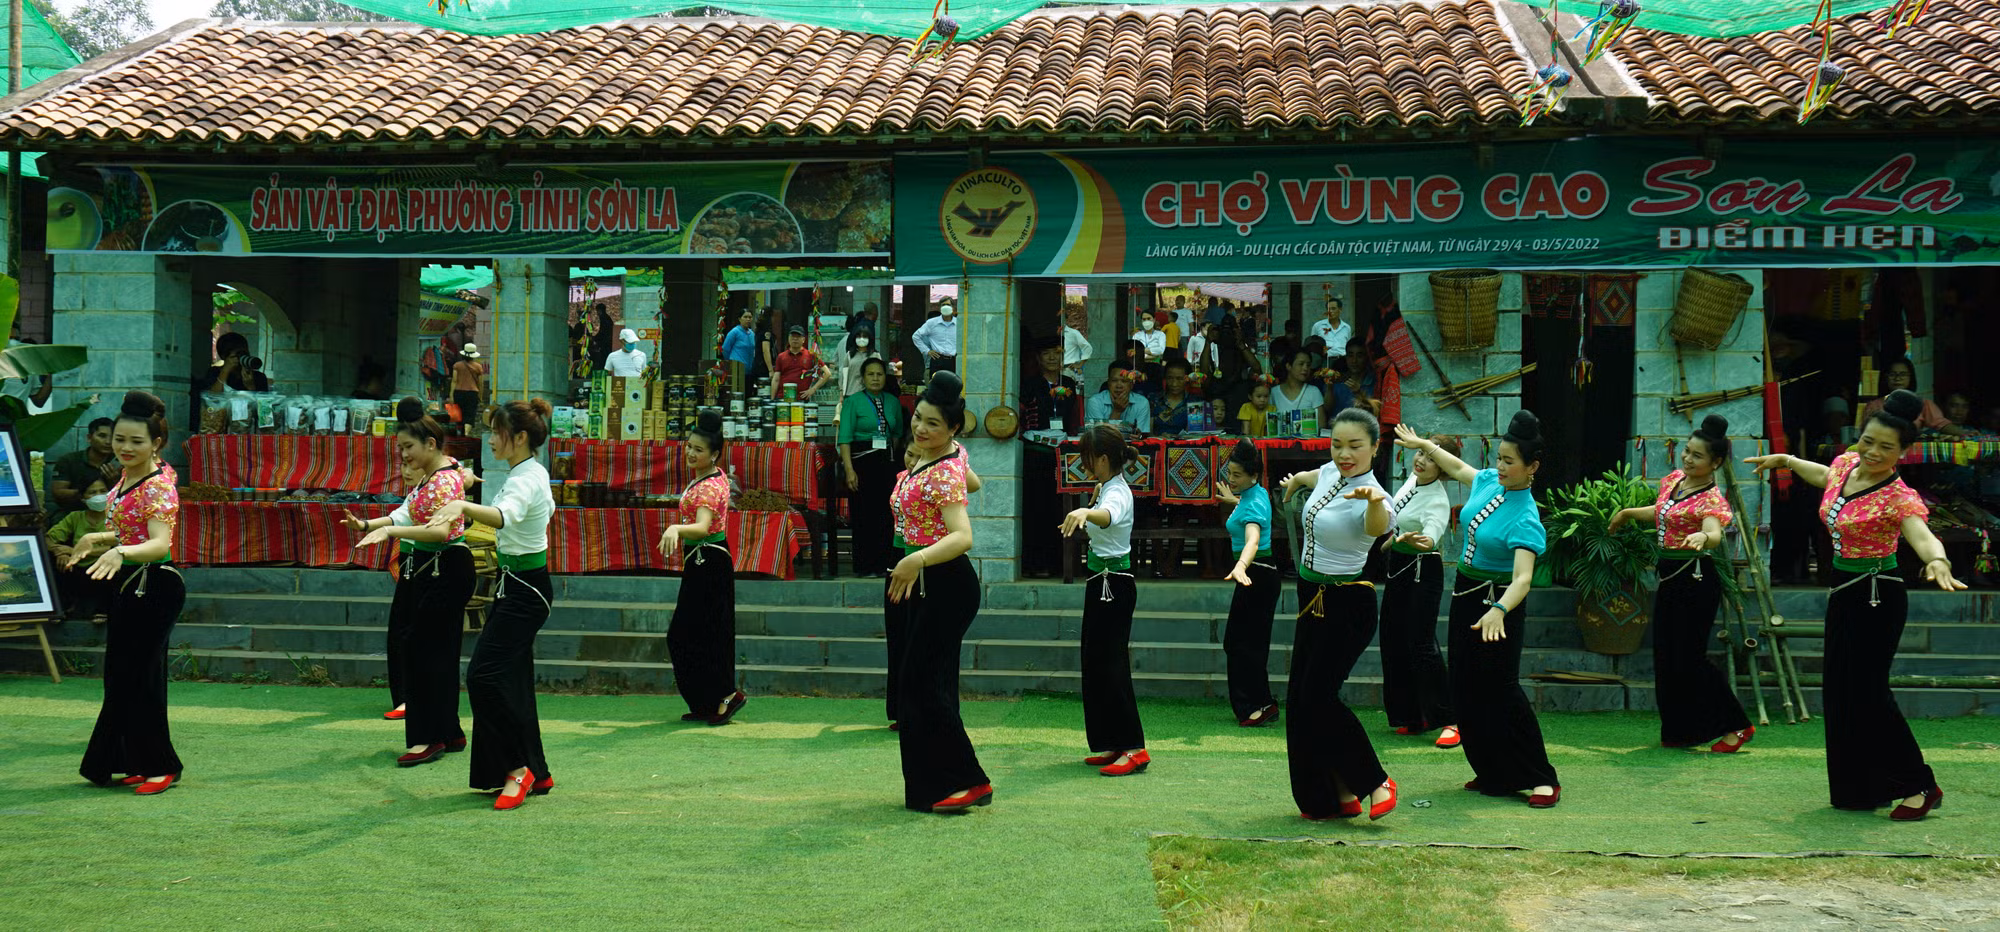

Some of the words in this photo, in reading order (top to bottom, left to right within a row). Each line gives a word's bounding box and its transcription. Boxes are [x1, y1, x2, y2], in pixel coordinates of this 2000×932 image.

[955, 173, 1022, 195] VINACULTO
[1142, 171, 1269, 236] CHỢ
[1279, 164, 1464, 225] VÙNG
[1481, 170, 1609, 221] CAO
[1628, 157, 1811, 216] Sơn
[1821, 153, 1964, 214] La
[250, 173, 301, 231] SẢN
[306, 177, 354, 242] VẬT
[359, 188, 402, 243] ĐỊA
[407, 180, 513, 233] PHƯƠNG
[518, 171, 581, 232] TỈNH
[585, 179, 639, 232] SƠN
[646, 187, 680, 232] LA
[955, 240, 966, 251] HÓA
[989, 250, 1001, 258] CÁC
[1000, 246, 1013, 256] DÂN
[1012, 240, 1022, 249] TỘC
[1020, 229, 1029, 240] VIỆT
[1145, 242, 1179, 258] LÀNG
[1180, 242, 1206, 257] VĂN
[1208, 242, 1234, 257] HÓA
[1243, 243, 1262, 256] DU
[1264, 242, 1293, 258] LỊCH
[1294, 240, 1317, 255] CÁC
[1318, 240, 1347, 255] DÂN
[1348, 240, 1370, 257] TỘC
[1373, 239, 1401, 256] VIỆT
[1401, 240, 1435, 255] NAM,
[1438, 238, 1458, 253] TỪ
[1457, 237, 1491, 253] NGÀY
[1492, 239, 1522, 252] 29/4
[1532, 238, 1600, 251] 03/5/2022
[1657, 219, 1806, 249] ĐIỂM
[1824, 225, 1936, 249] HẸN
